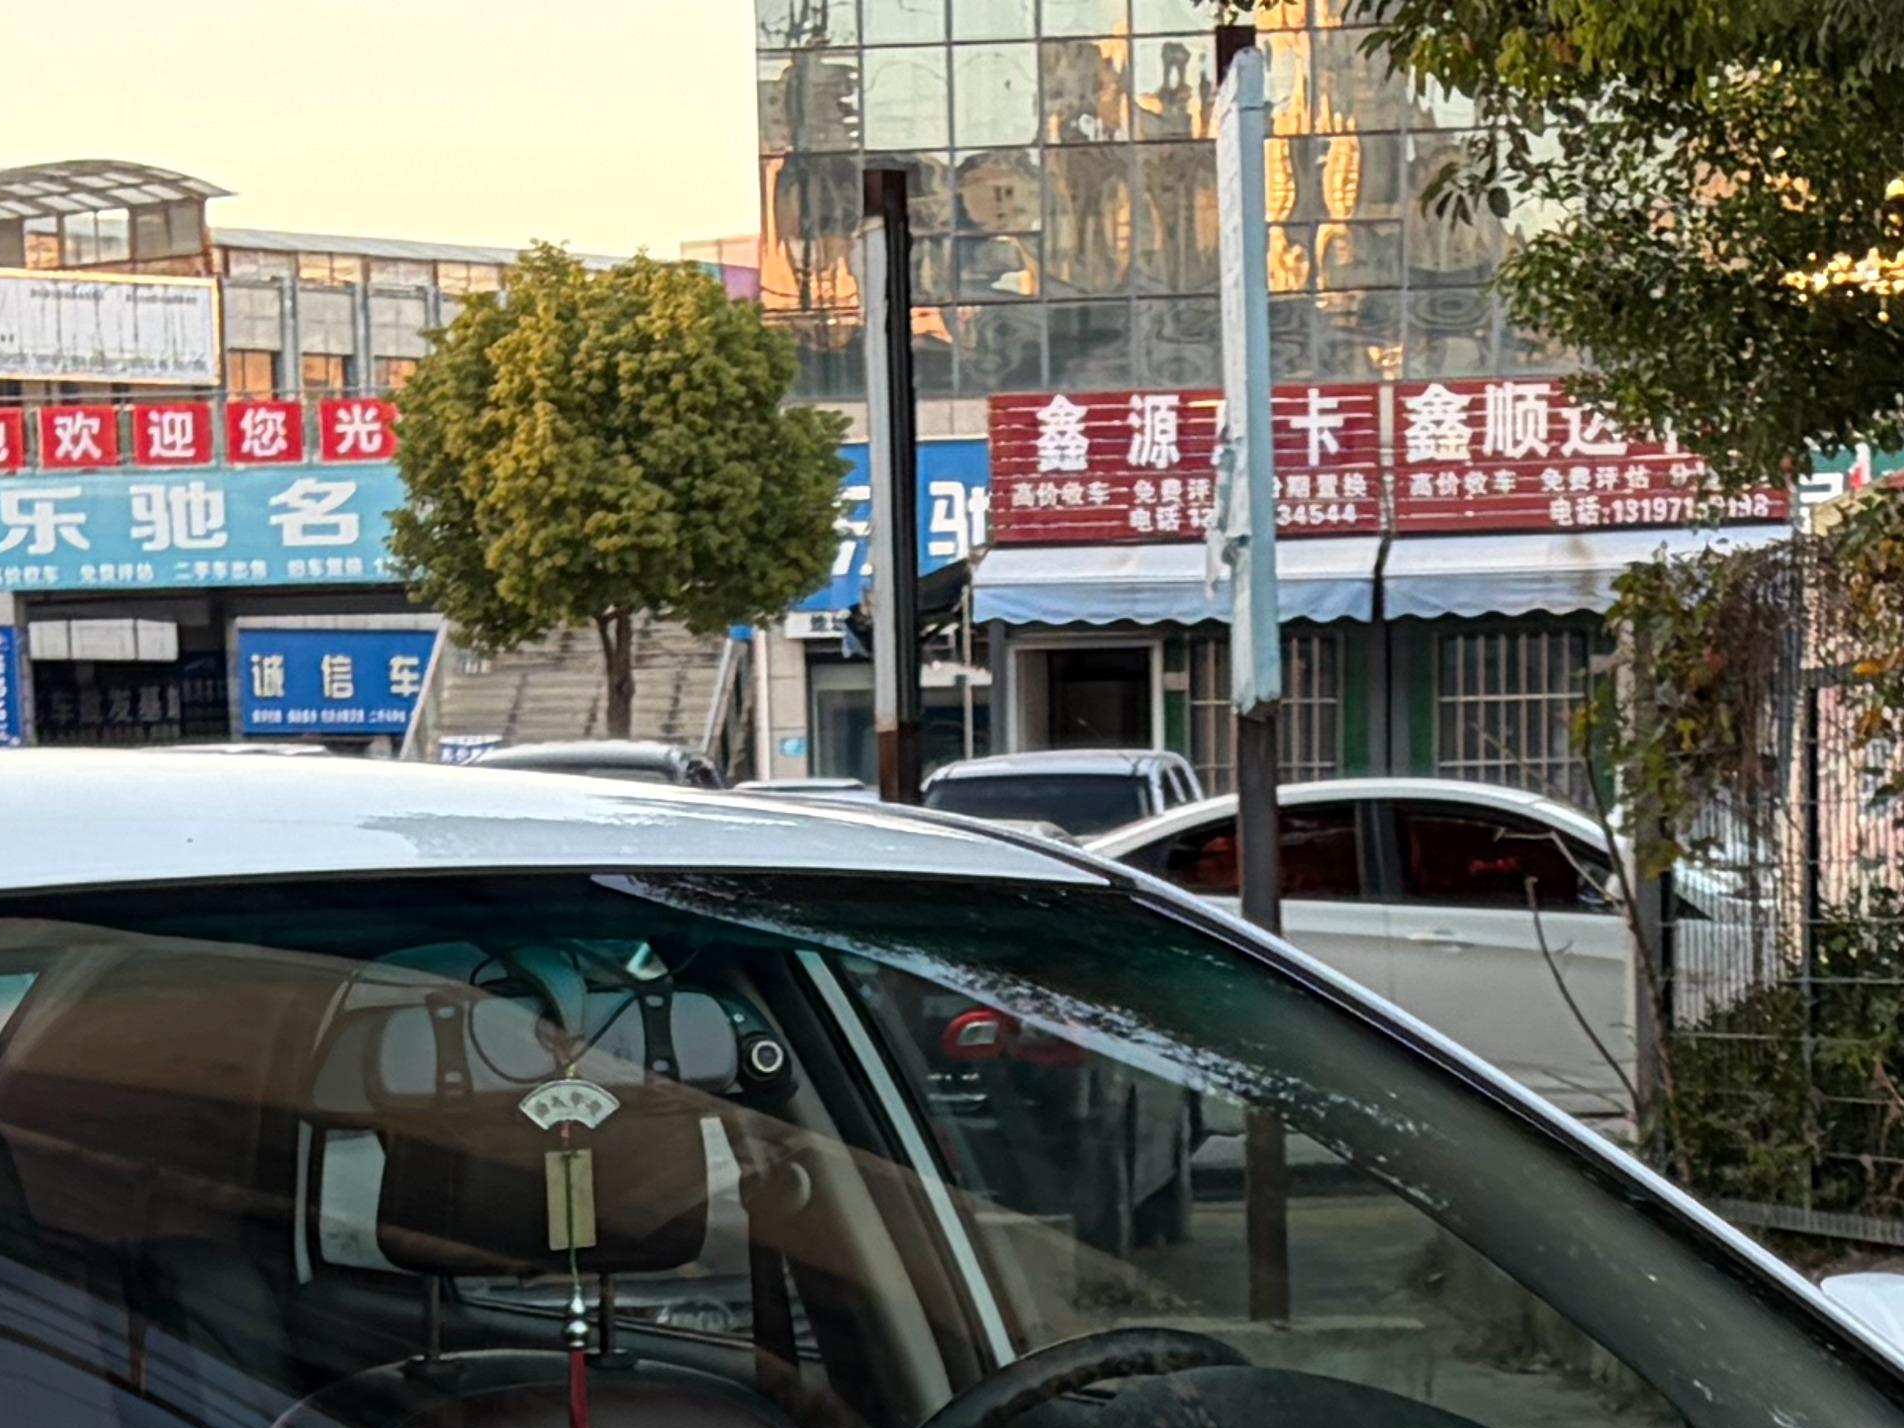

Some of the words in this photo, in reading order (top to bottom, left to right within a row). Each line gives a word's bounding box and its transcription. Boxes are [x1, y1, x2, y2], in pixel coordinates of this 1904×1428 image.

[1036, 388, 1344, 471] 鑫源卡
[1404, 382, 1679, 463] 鑫顺达
[1011, 481, 1111, 507] 高价收车
[1133, 477, 1211, 503] 免费评
[1409, 469, 1517, 497] 高价收车
[1540, 465, 1651, 492] 免费评估
[1130, 507, 1181, 531] 电话
[250, 654, 420, 698] 诚信车
